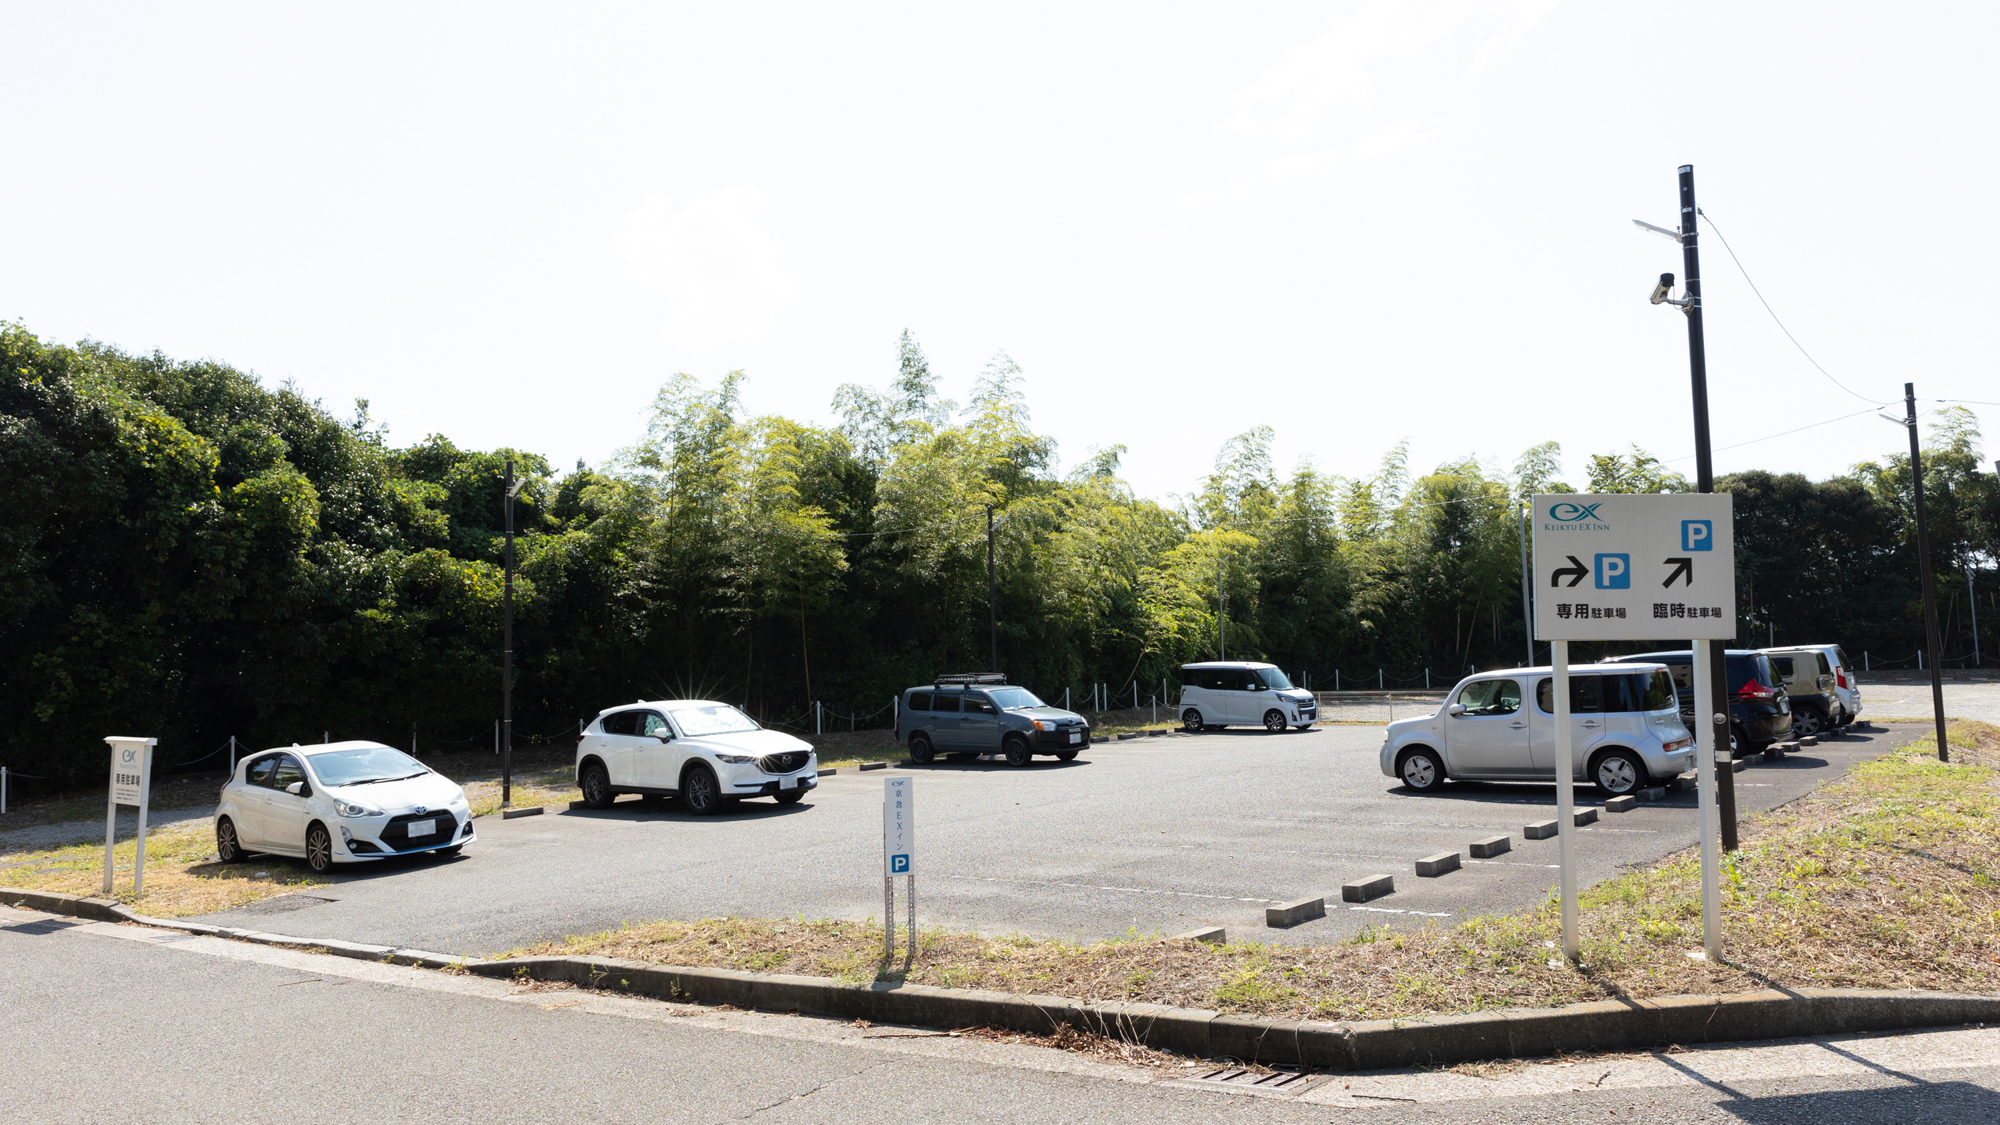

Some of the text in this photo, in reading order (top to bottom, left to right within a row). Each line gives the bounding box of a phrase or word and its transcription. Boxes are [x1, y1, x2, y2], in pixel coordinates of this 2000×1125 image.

[1544, 523, 1610, 531] KEIKYU EX INN
[1688, 523, 1708, 549] P
[1602, 557, 1625, 586] P
[1556, 603, 1627, 619] 専用駐車場
[1653, 602, 1722, 619] 臨時駐車場
[895, 789, 904, 851] 京急EXイン
[895, 857, 907, 871] P
